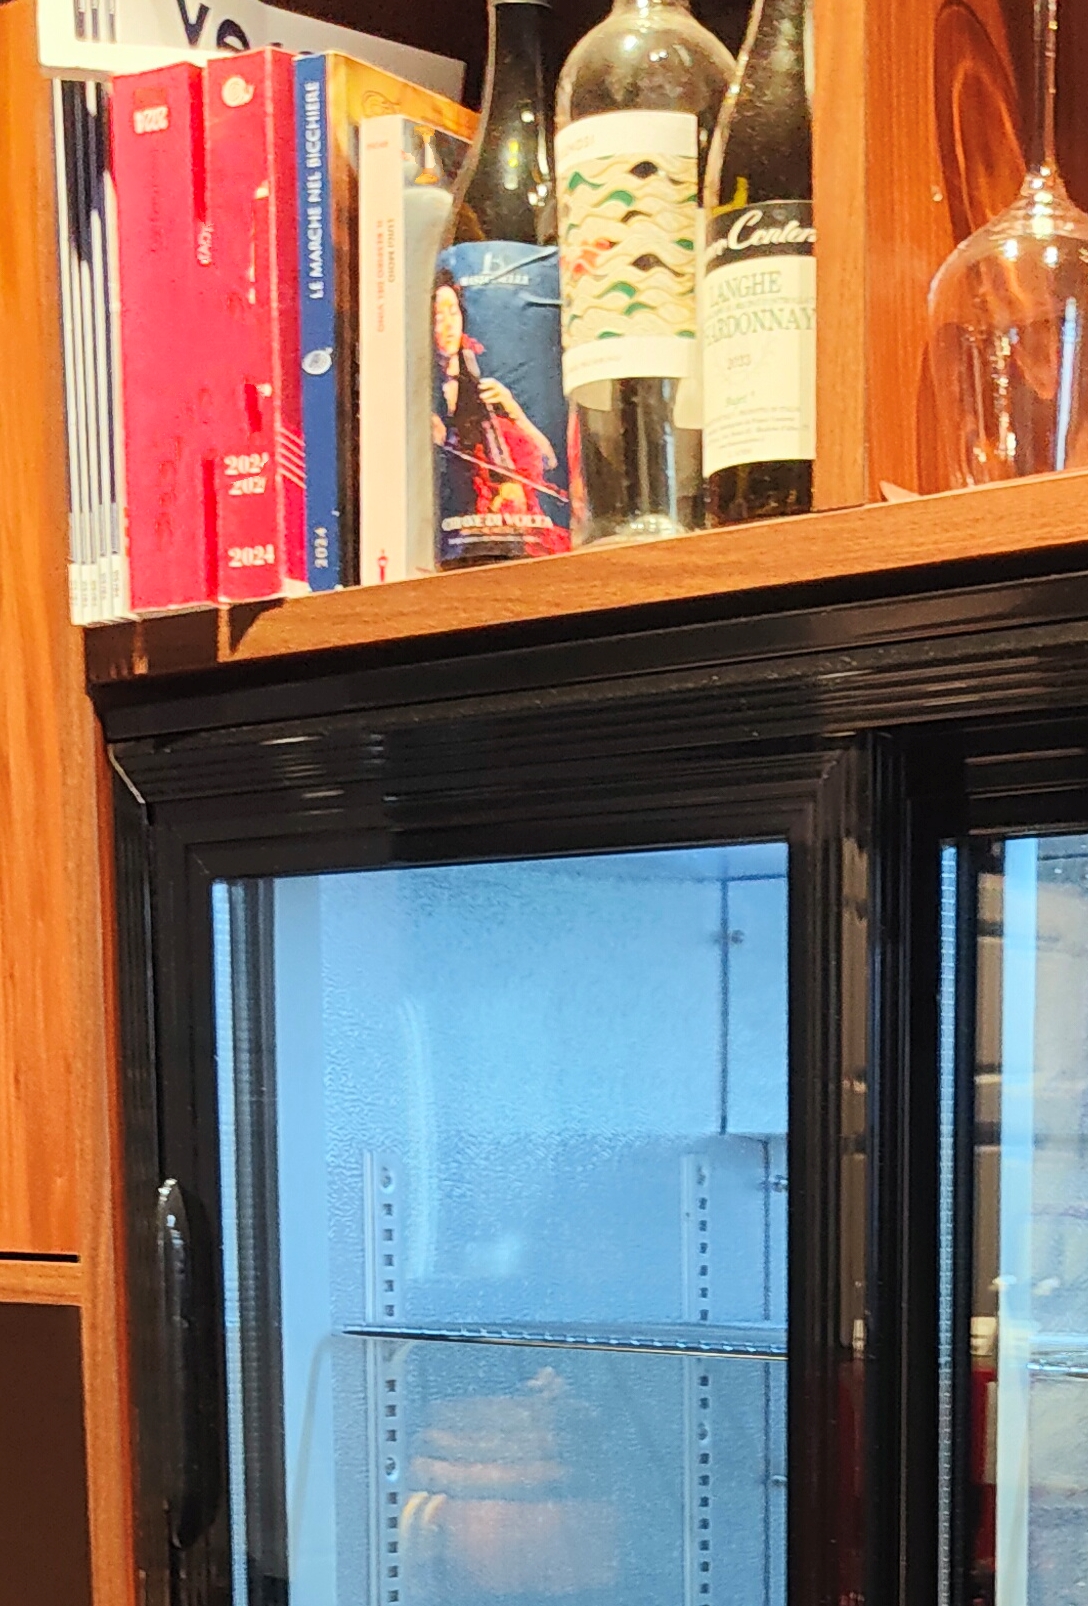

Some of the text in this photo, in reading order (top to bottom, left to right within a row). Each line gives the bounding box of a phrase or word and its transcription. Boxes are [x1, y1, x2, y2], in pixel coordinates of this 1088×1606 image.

[304, 80, 324, 299] LE MARCHE NEL BICCHIERE
[227, 543, 275, 568] 2024
[313, 527, 329, 569] 2024
